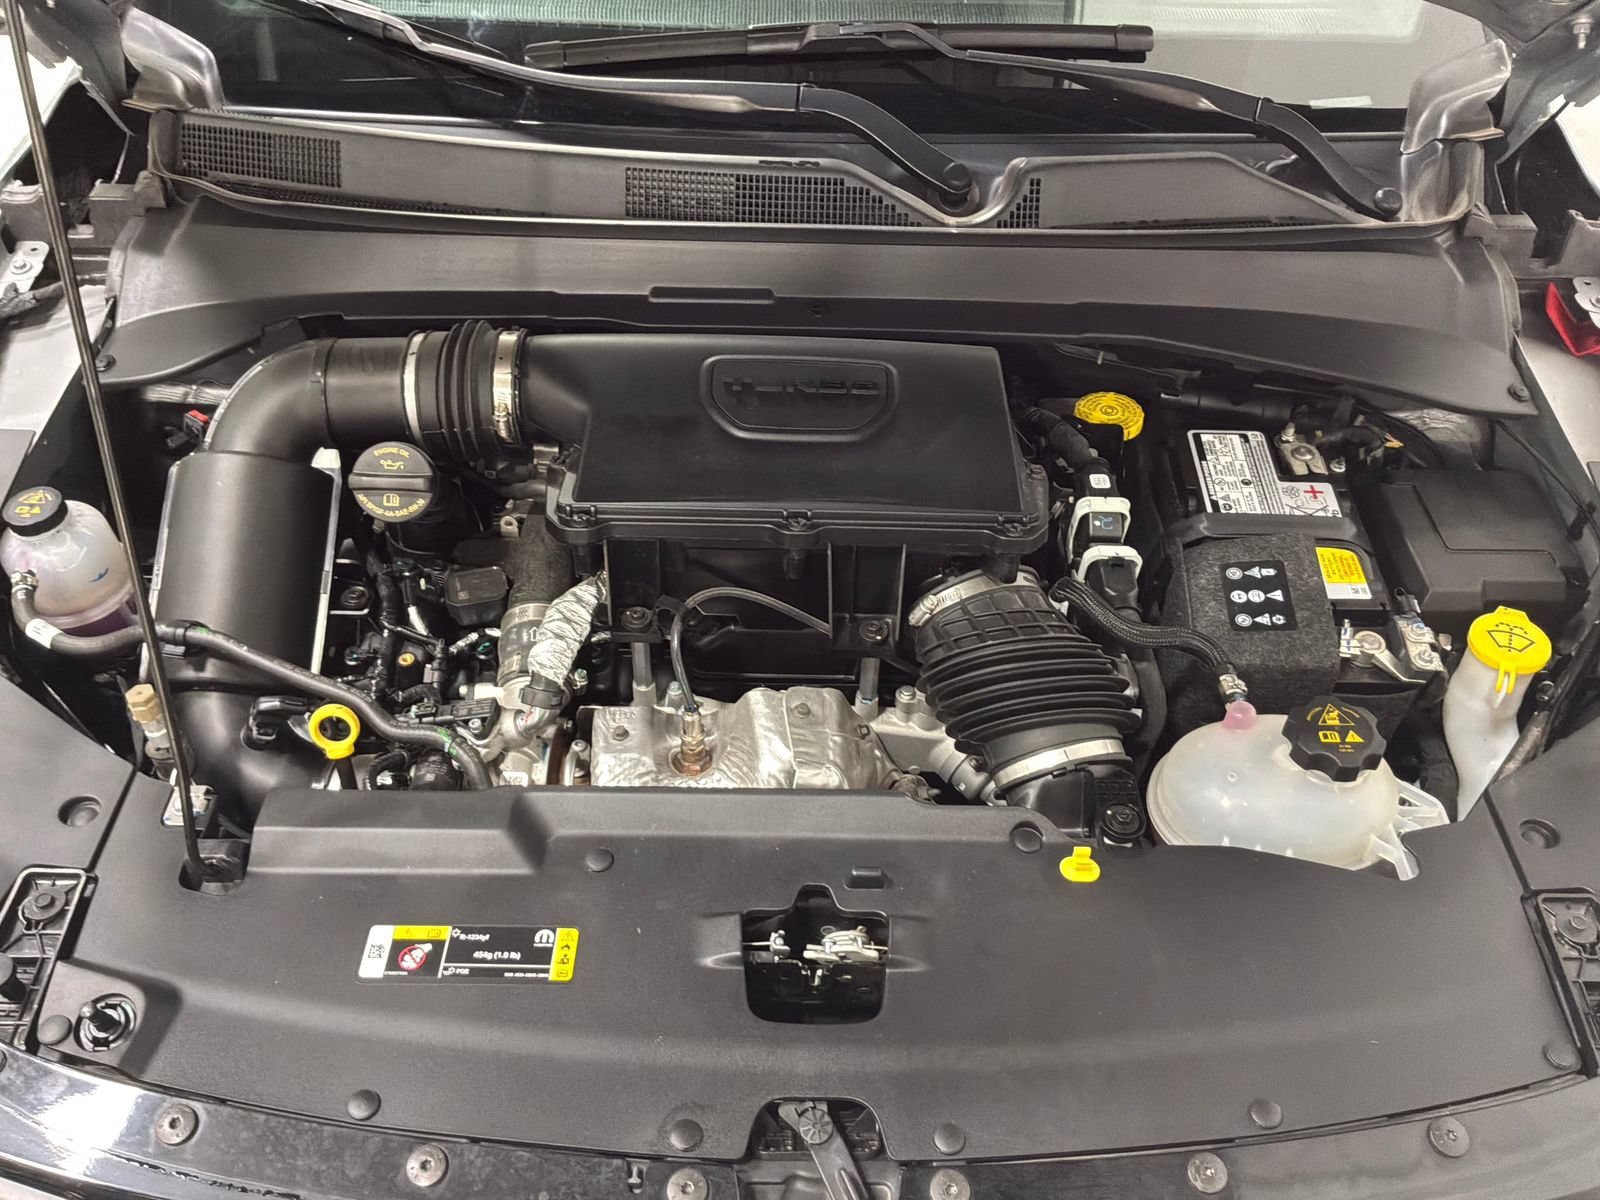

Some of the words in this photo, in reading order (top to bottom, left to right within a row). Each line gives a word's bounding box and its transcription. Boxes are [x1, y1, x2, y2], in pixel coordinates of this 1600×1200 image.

[373, 447, 399, 457] ENGINE
[399, 448, 410, 458] OIL
[473, 951, 493, 960] 454g
[494, 951, 508, 960] (1.0
[510, 951, 521, 960] lb)
